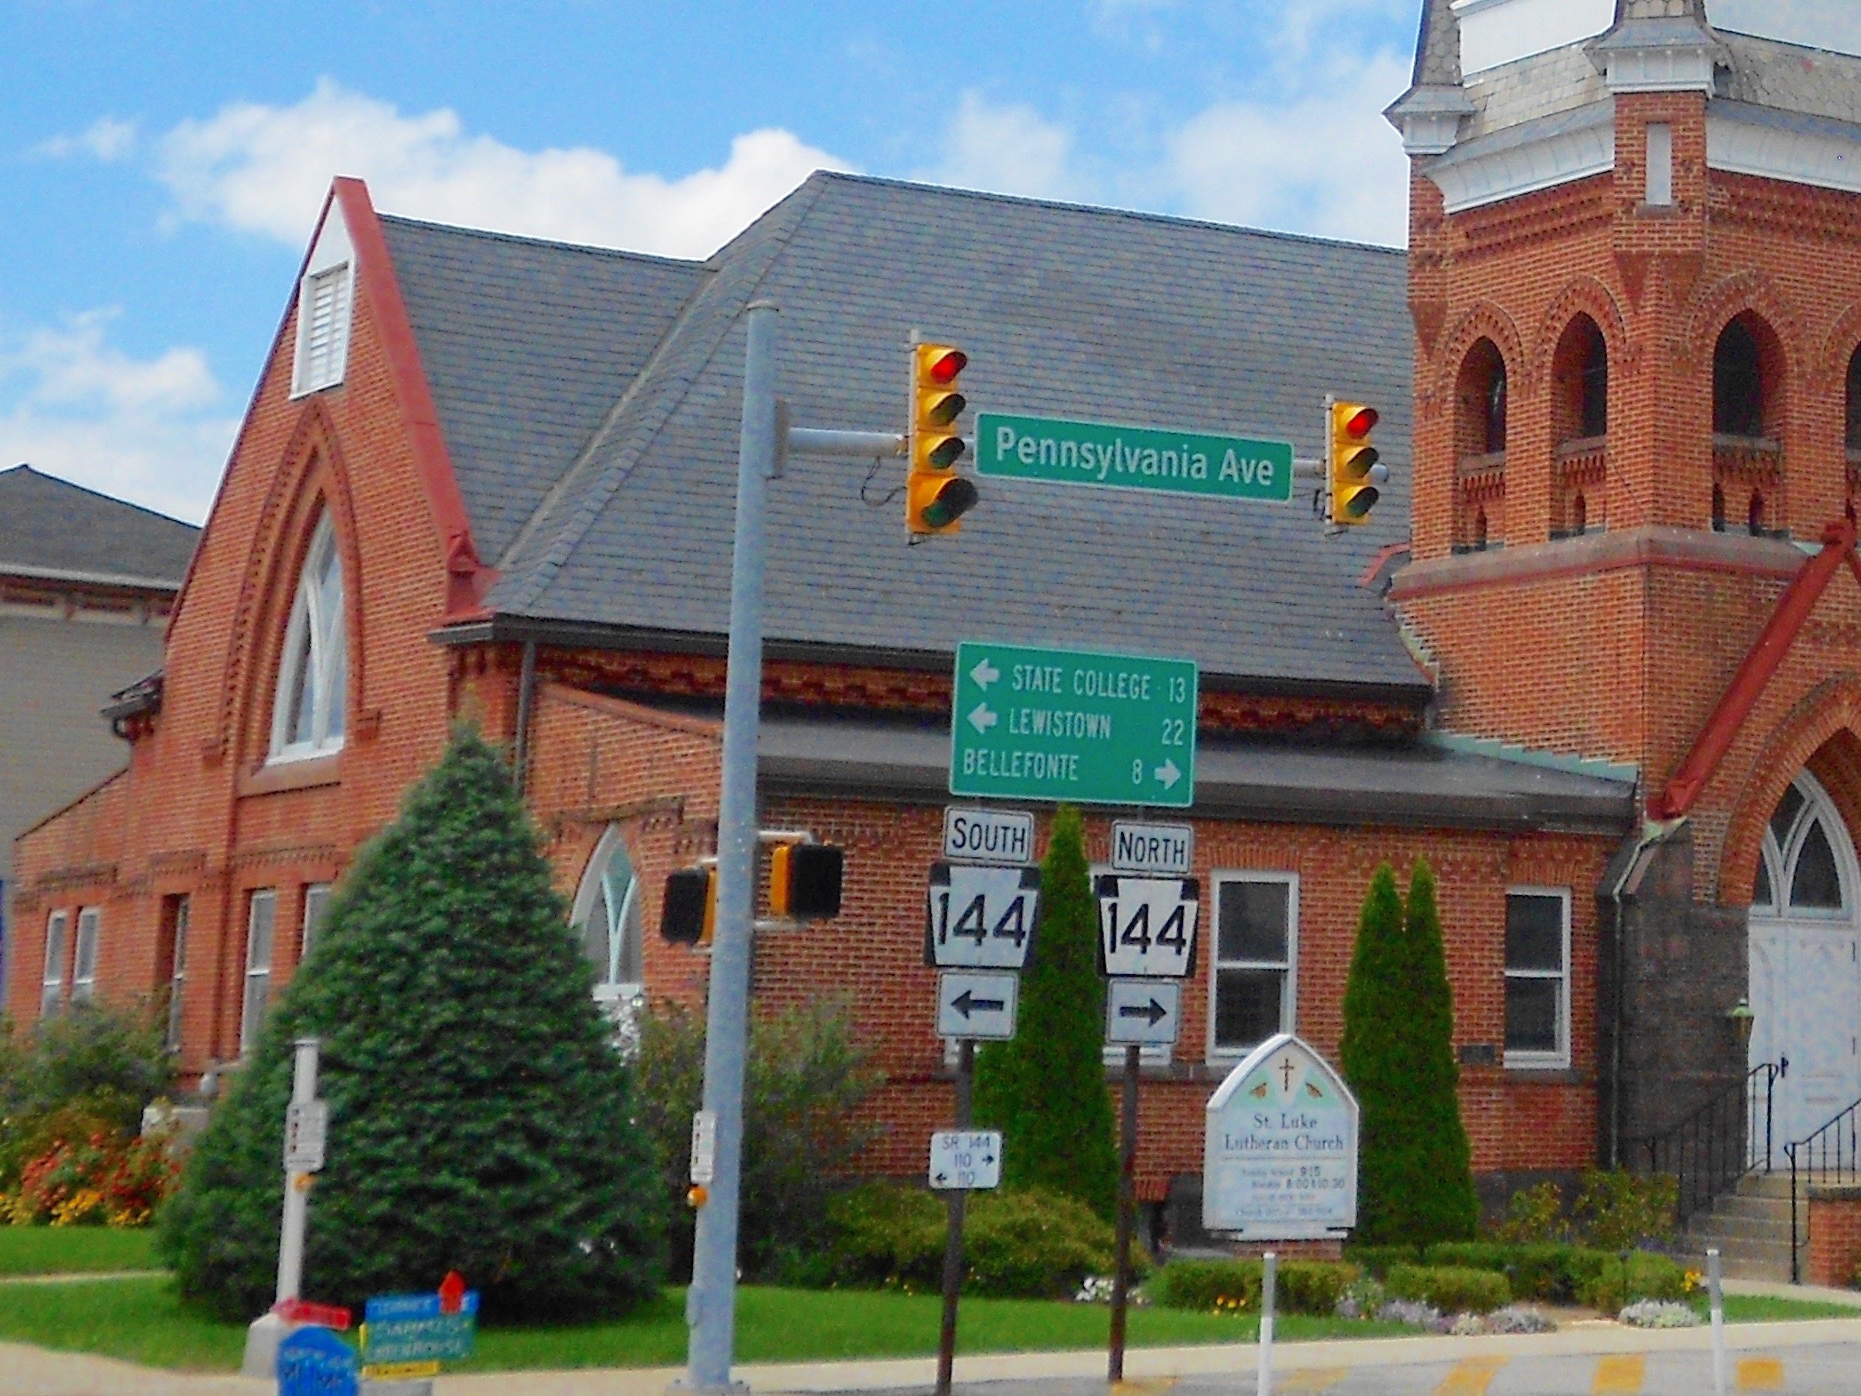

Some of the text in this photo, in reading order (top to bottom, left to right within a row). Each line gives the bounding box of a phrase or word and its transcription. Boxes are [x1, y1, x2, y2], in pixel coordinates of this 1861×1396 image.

[996, 426, 1274, 486] Pennsylvania Ave
[1012, 664, 1185, 703] STATE COLLEGE 13
[1009, 708, 1184, 746] LEWISTOWN 22
[963, 749, 1142, 785] BELLEFONTE 8
[952, 817, 1025, 853] SOUTH
[1118, 831, 1185, 864] NORTH
[939, 892, 1026, 948] 144
[1107, 902, 1187, 956] 144
[1281, 1113, 1318, 1129] Luke
[1224, 1134, 1344, 1151] Lutheran Church
